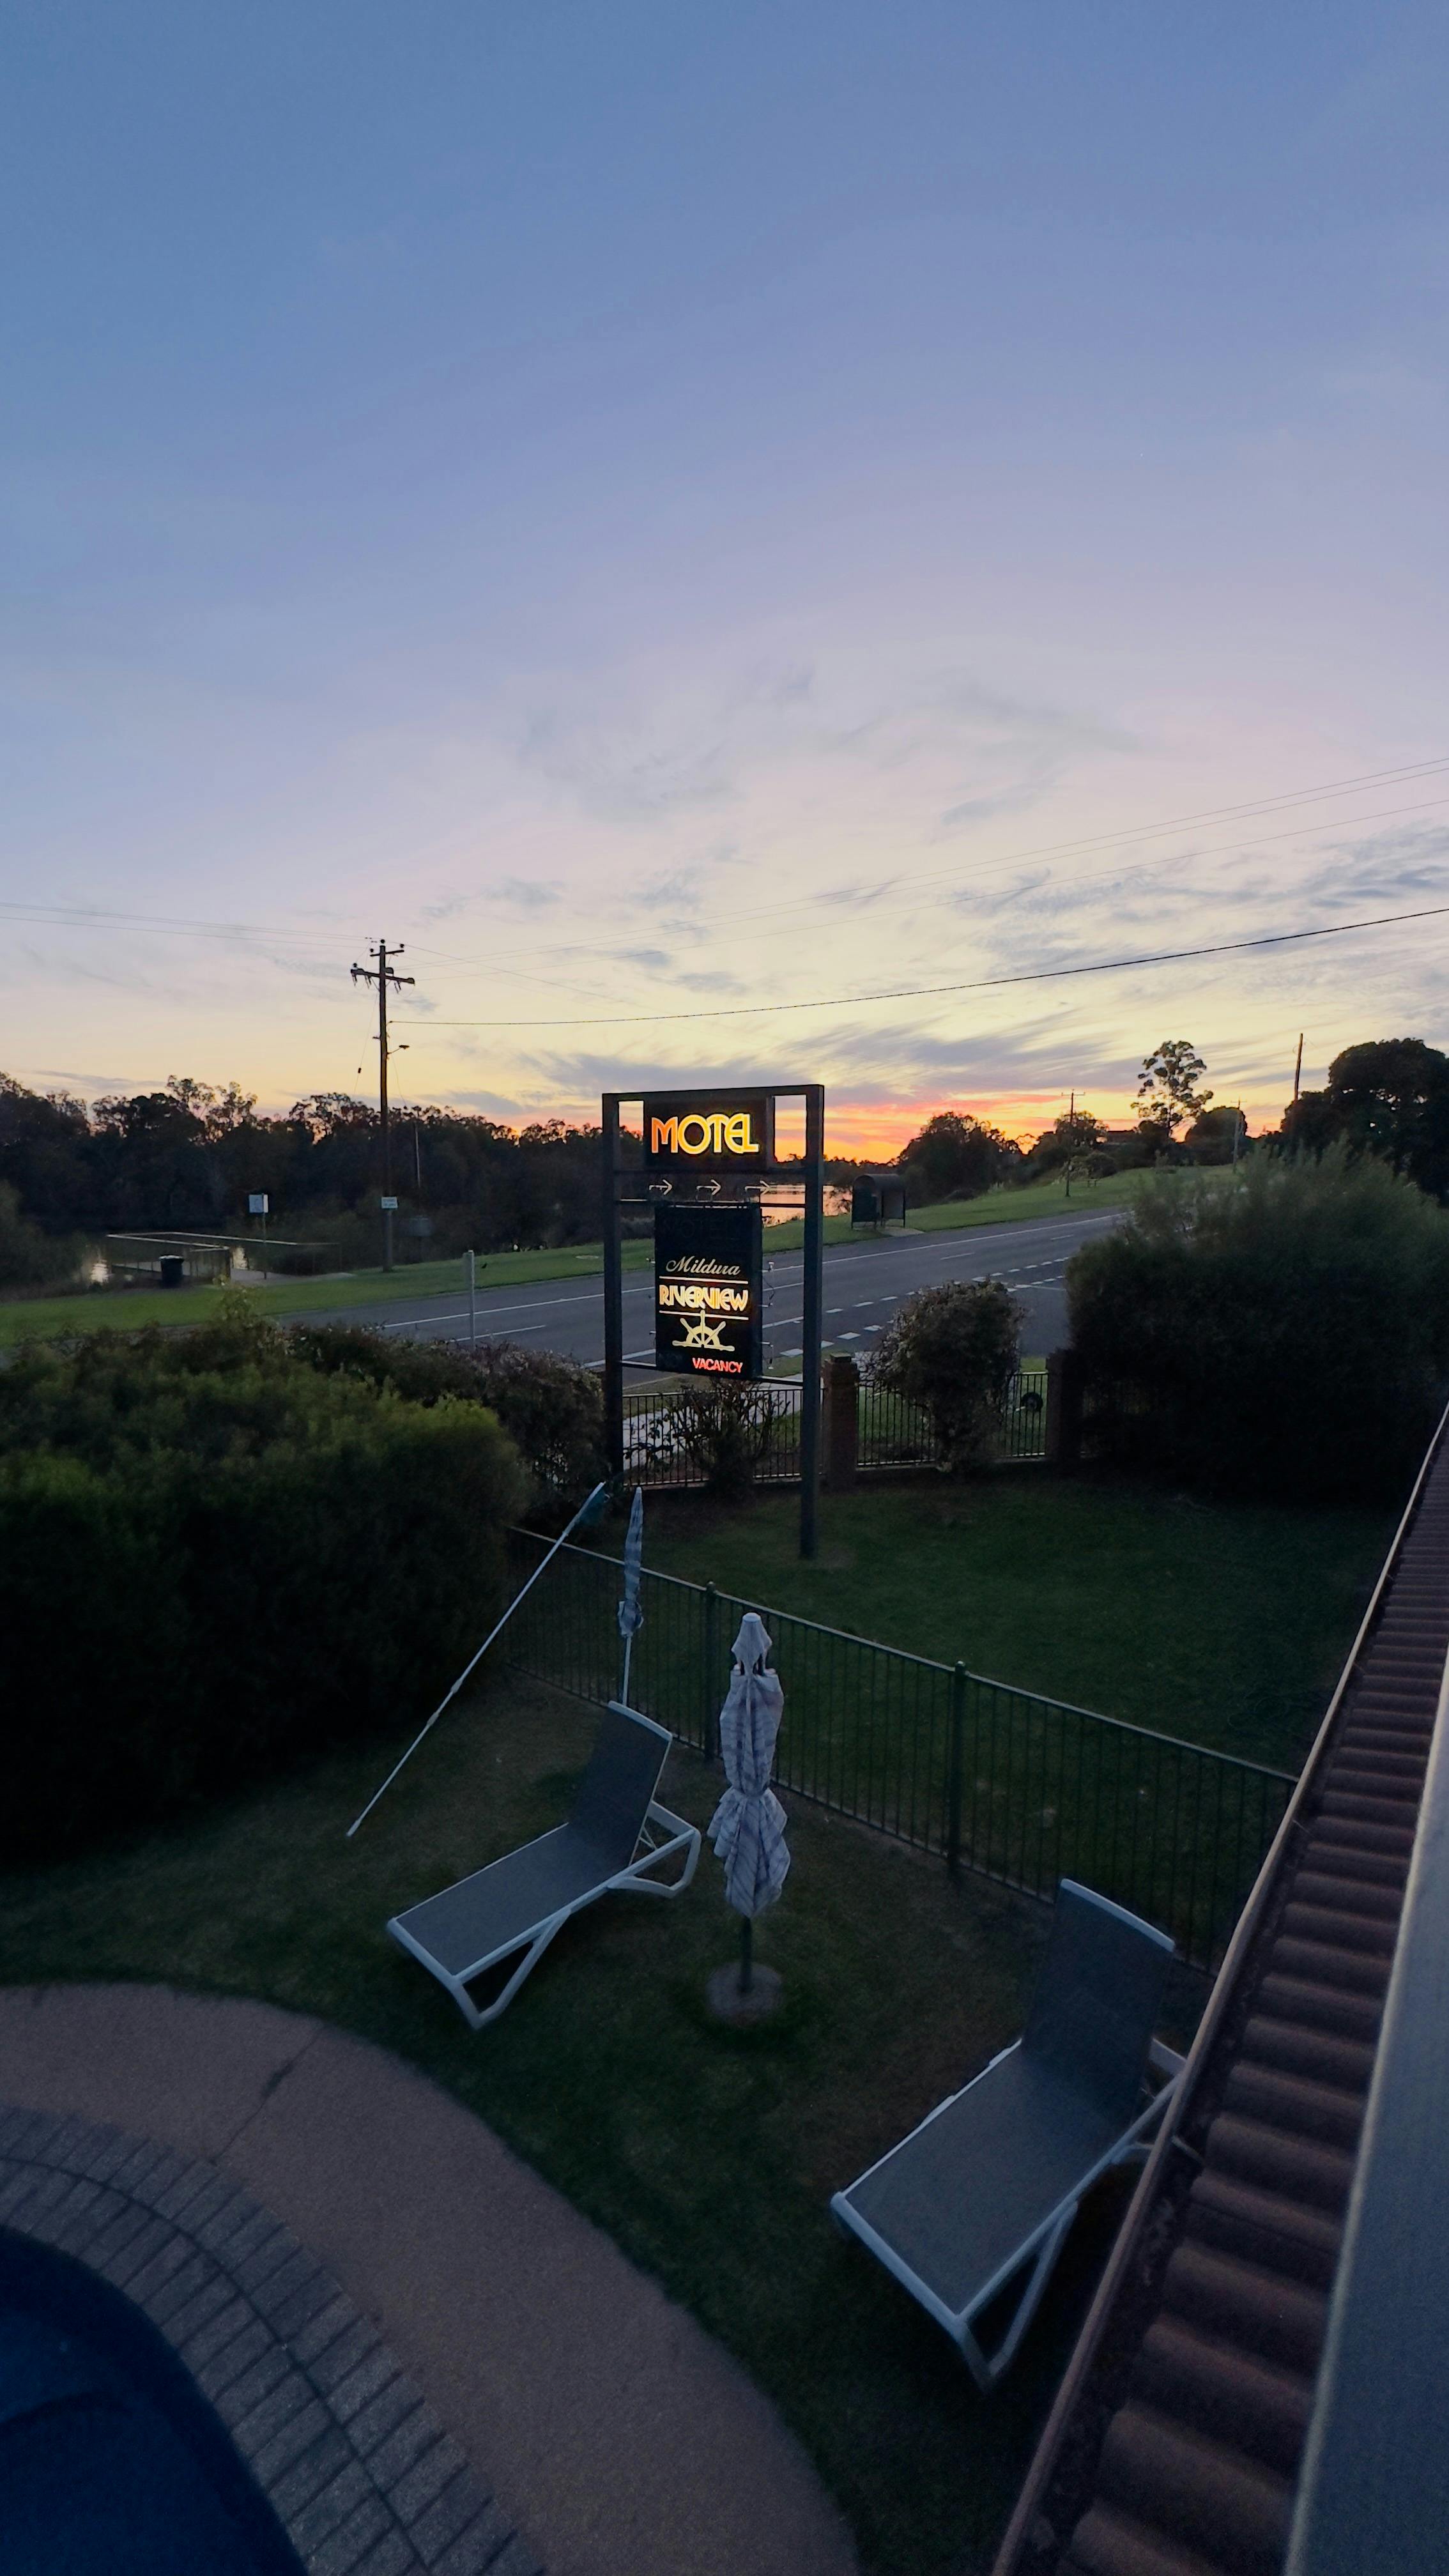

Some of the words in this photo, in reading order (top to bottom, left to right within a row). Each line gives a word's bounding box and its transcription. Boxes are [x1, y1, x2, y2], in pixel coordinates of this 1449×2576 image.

[652, 1114, 759, 1154] MOTEL
[666, 1255, 741, 1275] Mildura
[659, 1284, 749, 1312] RIVERVIEW
[692, 1357, 743, 1373] VACANCY
